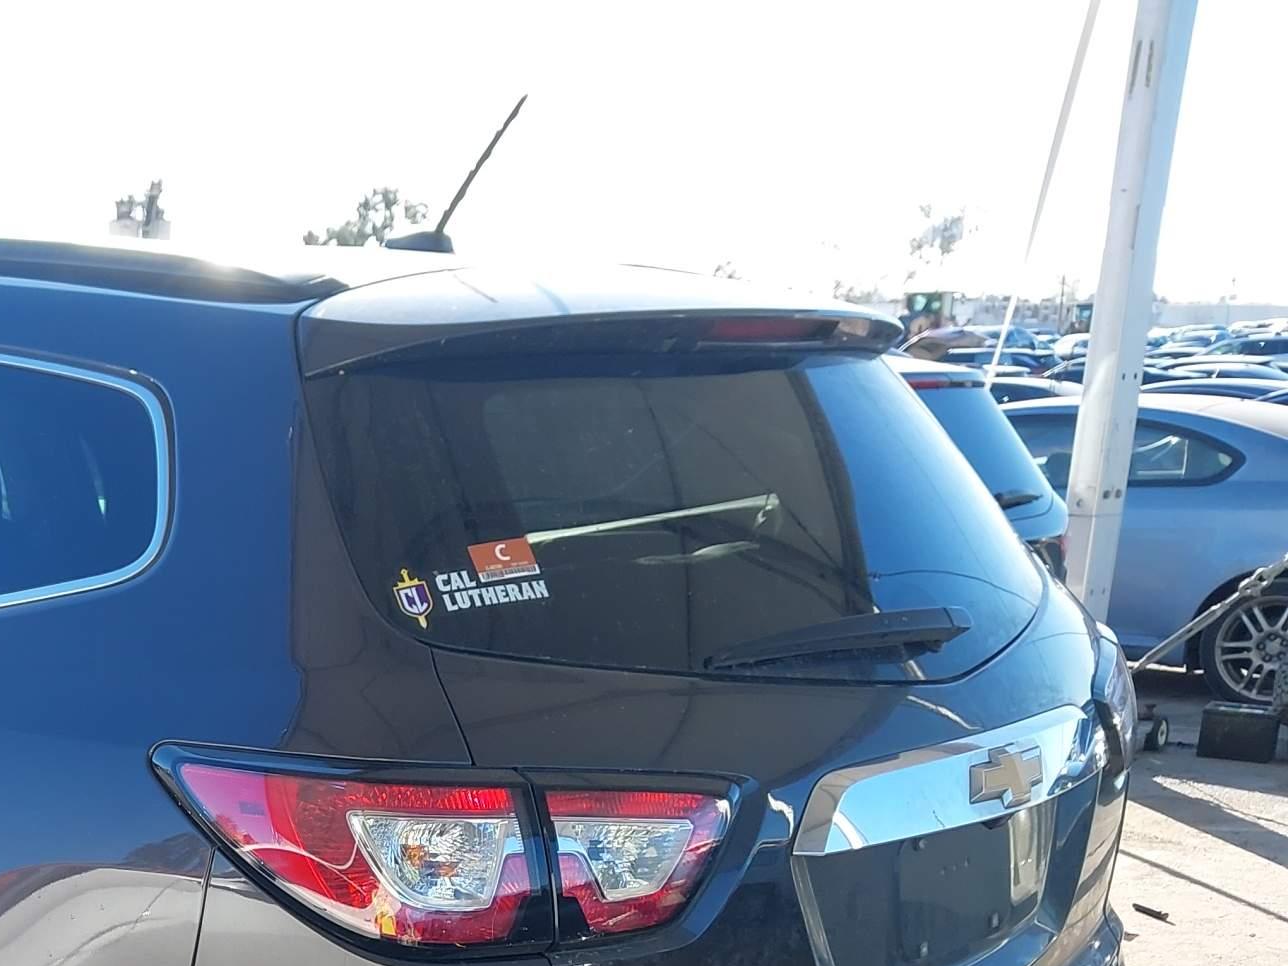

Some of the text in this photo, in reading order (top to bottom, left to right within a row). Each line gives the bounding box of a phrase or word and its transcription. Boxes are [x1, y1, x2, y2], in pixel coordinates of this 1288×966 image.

[495, 544, 511, 560] C
[435, 570, 476, 592] CAL
[442, 580, 550, 612] LUTHERAN
